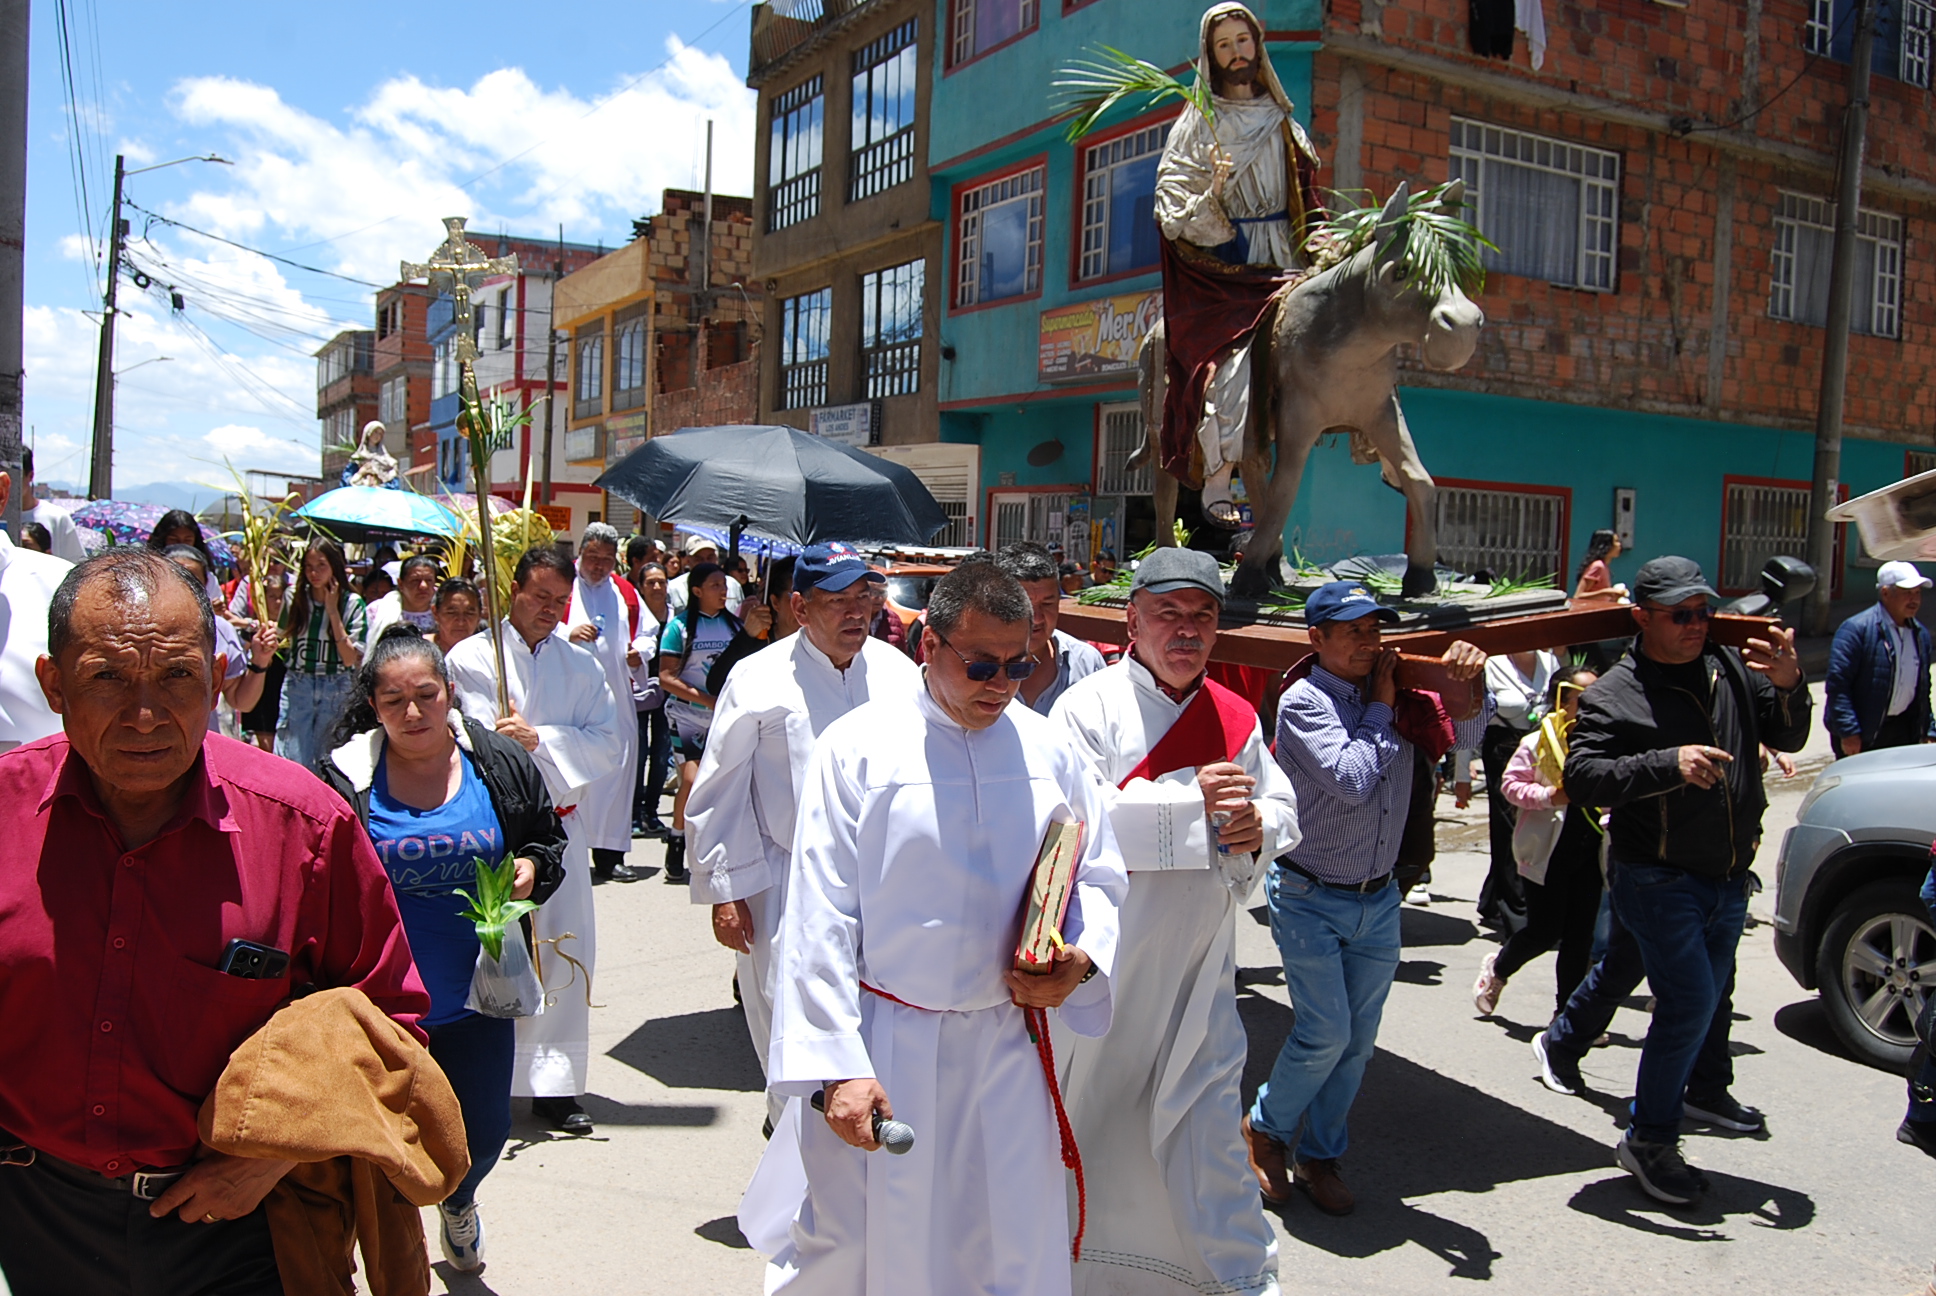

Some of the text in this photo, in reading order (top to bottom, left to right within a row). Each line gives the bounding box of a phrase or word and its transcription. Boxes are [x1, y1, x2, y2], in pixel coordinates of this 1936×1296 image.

[819, 408, 857, 423] FARMARKET
[692, 640, 724, 650] COMBO
[376, 827, 496, 864] TODAY
[392, 866, 437, 884] is
